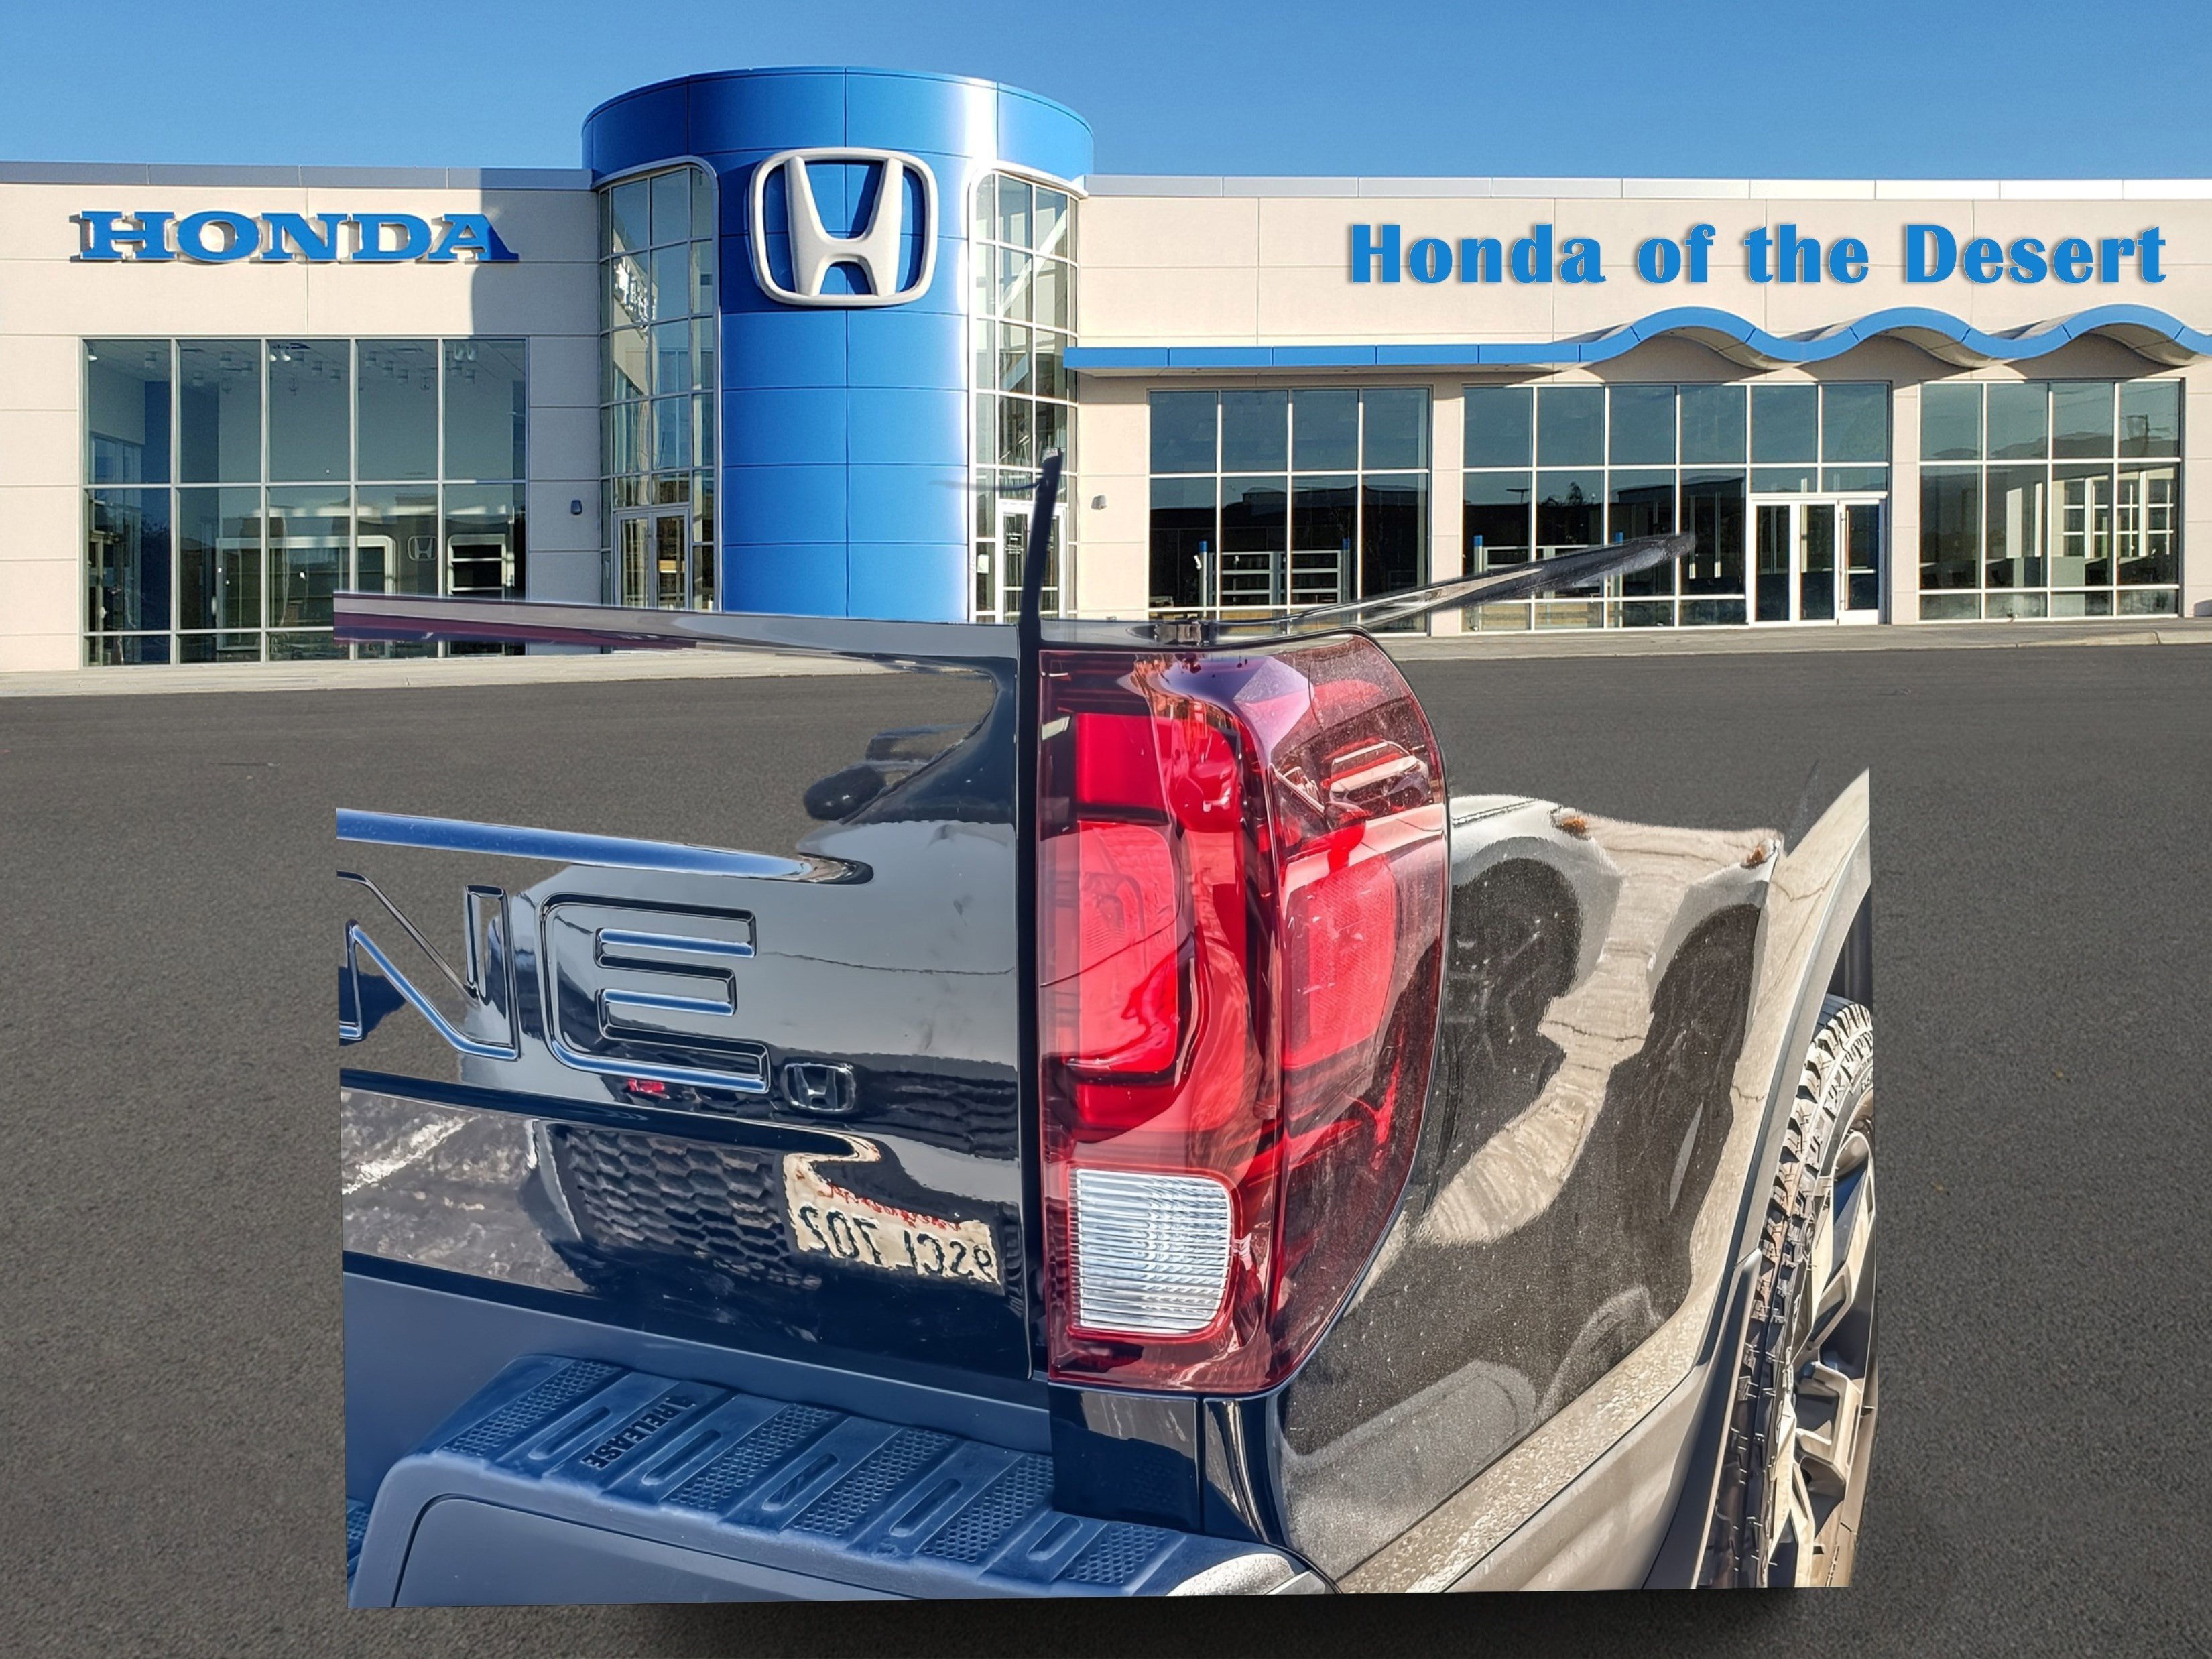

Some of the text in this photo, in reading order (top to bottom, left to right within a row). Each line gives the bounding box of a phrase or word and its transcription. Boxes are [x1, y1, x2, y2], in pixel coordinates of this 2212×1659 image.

[79, 211, 519, 262] HONDA
[1351, 223, 2167, 284] Honda of the Desert
[580, 1402, 683, 1469] RELEASE
